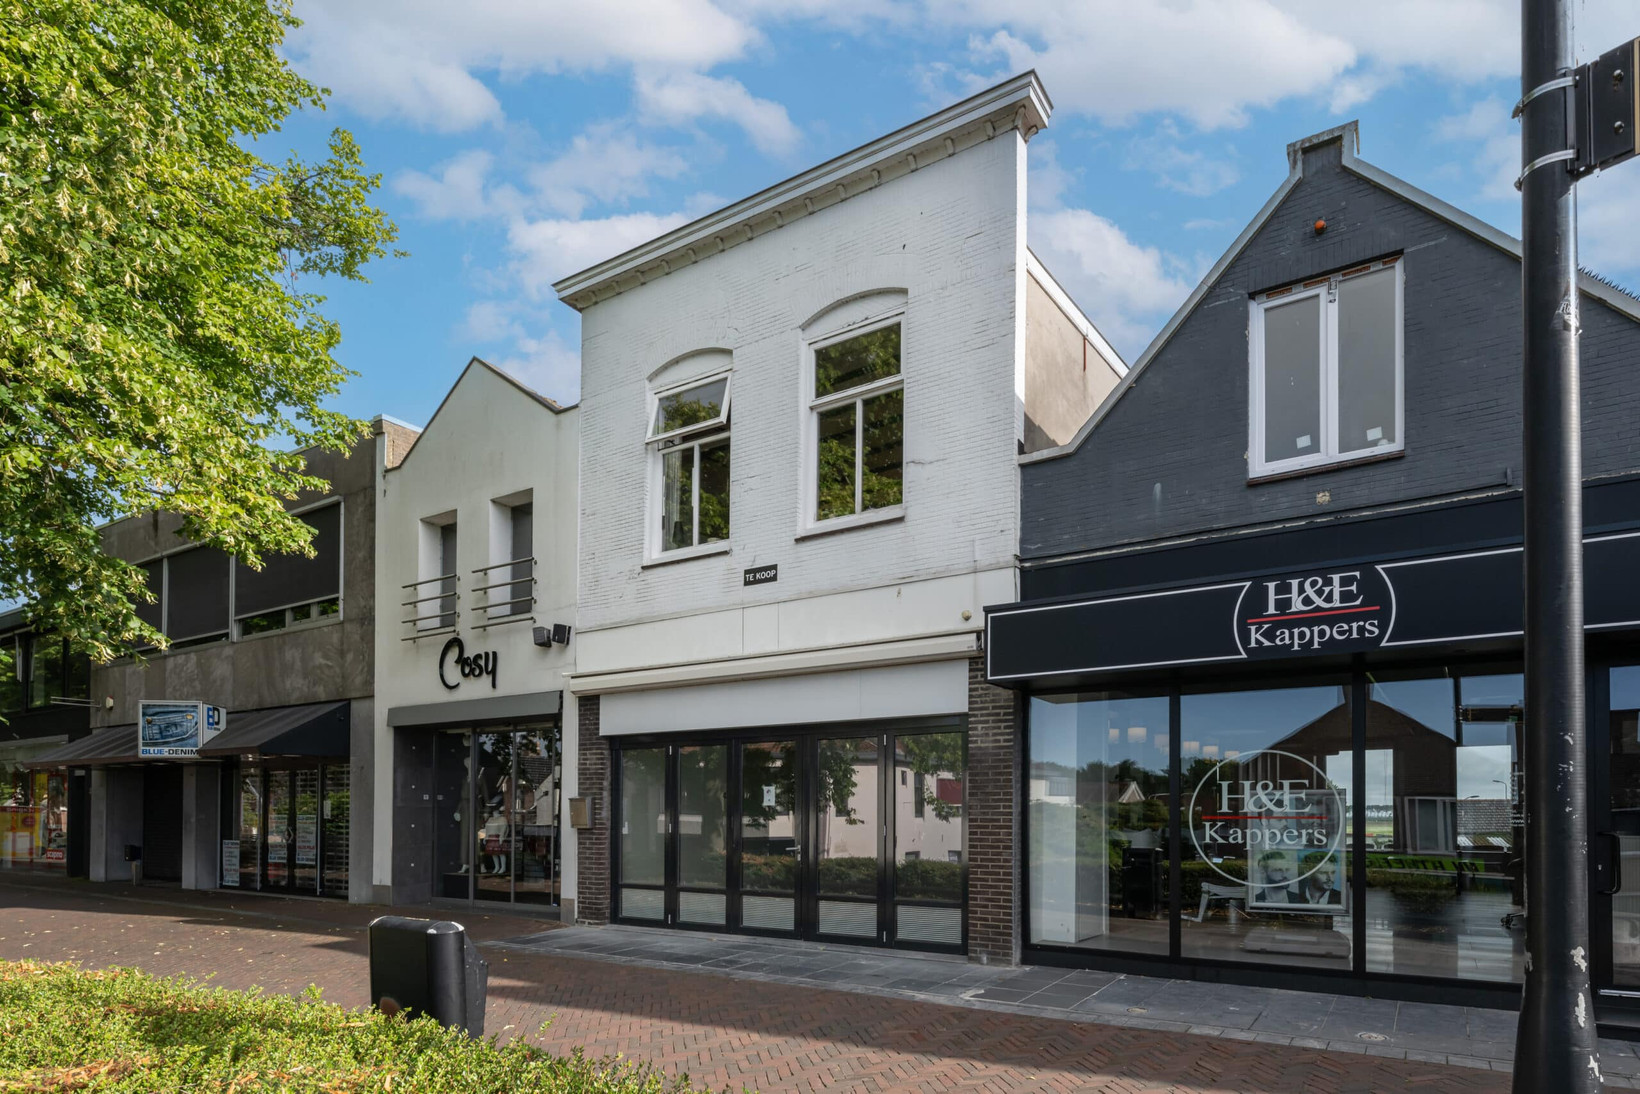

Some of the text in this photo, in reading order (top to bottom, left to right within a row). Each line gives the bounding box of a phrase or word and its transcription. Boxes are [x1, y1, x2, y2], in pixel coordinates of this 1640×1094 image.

[745, 569, 776, 581] TE KOOP
[1263, 571, 1363, 615] H&E
[1247, 619, 1379, 651] Kappers
[439, 636, 497, 690] Cosy
[1217, 779, 1312, 813] H&E
[1203, 821, 1327, 850] Kappers
